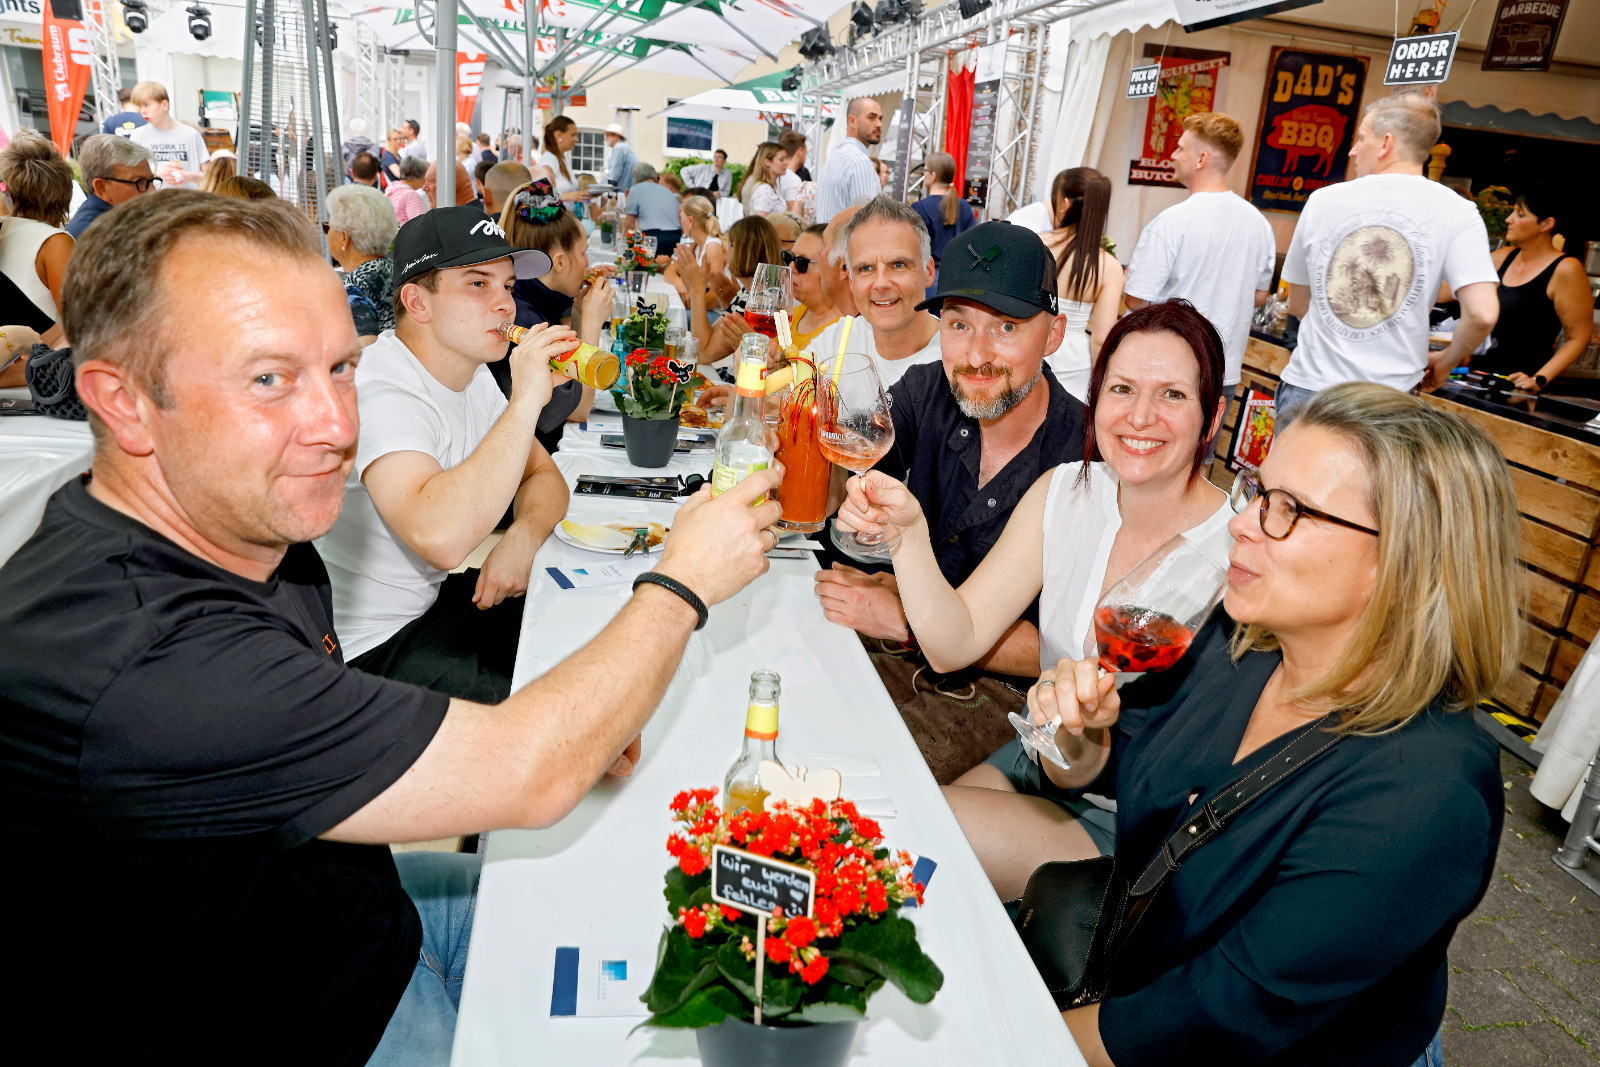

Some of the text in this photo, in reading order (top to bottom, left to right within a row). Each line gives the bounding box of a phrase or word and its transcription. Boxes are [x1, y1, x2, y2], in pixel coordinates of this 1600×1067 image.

[1500, 1, 1562, 19] BARBECUE
[49, 25, 66, 82] Clubraum
[1395, 39, 1450, 60] ORDER
[1130, 68, 1158, 83] PICK UP
[1160, 57, 1228, 79] EUHEIT
[1273, 64, 1356, 105] DAD'S
[1278, 120, 1335, 154] BBQ
[1130, 169, 1176, 182] BUTC
[1247, 399, 1276, 407] NEUHE
[722, 884, 776, 911] fehlen
[741, 877, 778, 899] euch
